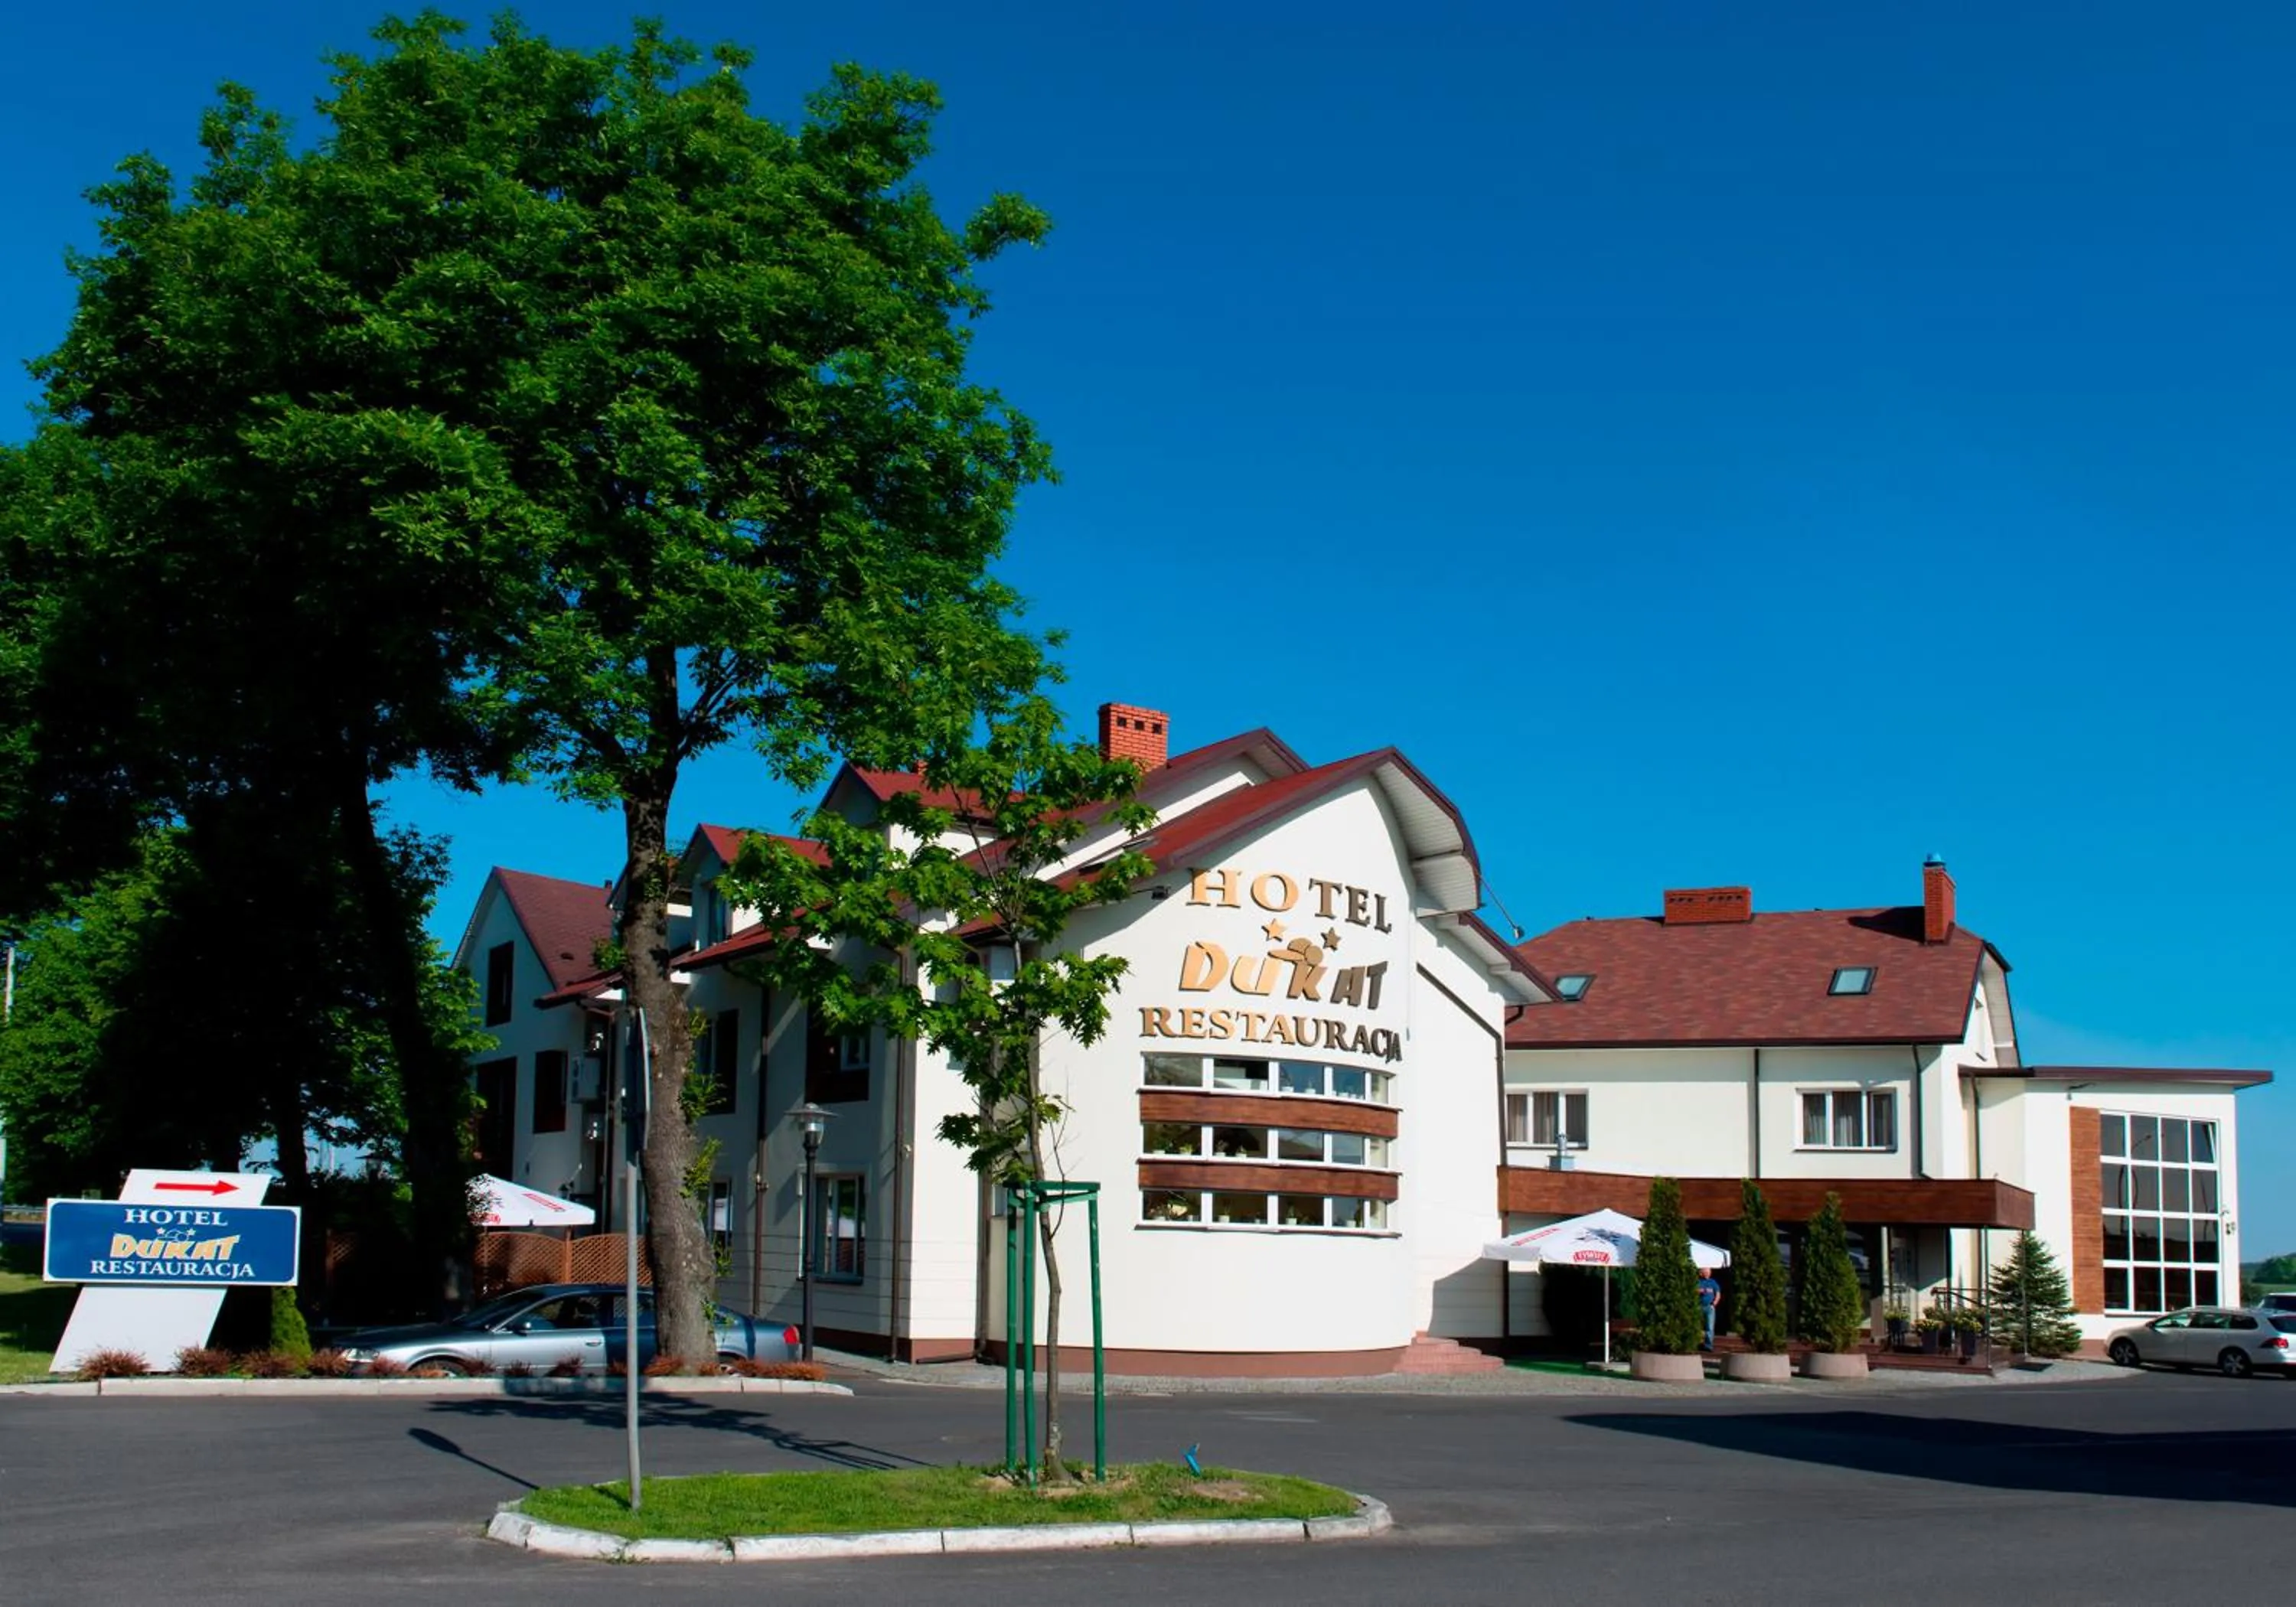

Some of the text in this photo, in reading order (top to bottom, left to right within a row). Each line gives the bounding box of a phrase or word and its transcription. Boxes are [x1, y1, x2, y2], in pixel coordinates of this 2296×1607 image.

[1186, 867, 1393, 934] HOTEL
[1179, 940, 1388, 1010] DUKAT
[1139, 1006, 1402, 1064] RESTAURACJA
[124, 1208, 229, 1226] HOTEL
[109, 1232, 241, 1260] DUKAT
[90, 1260, 255, 1279] RESTAURACJA
